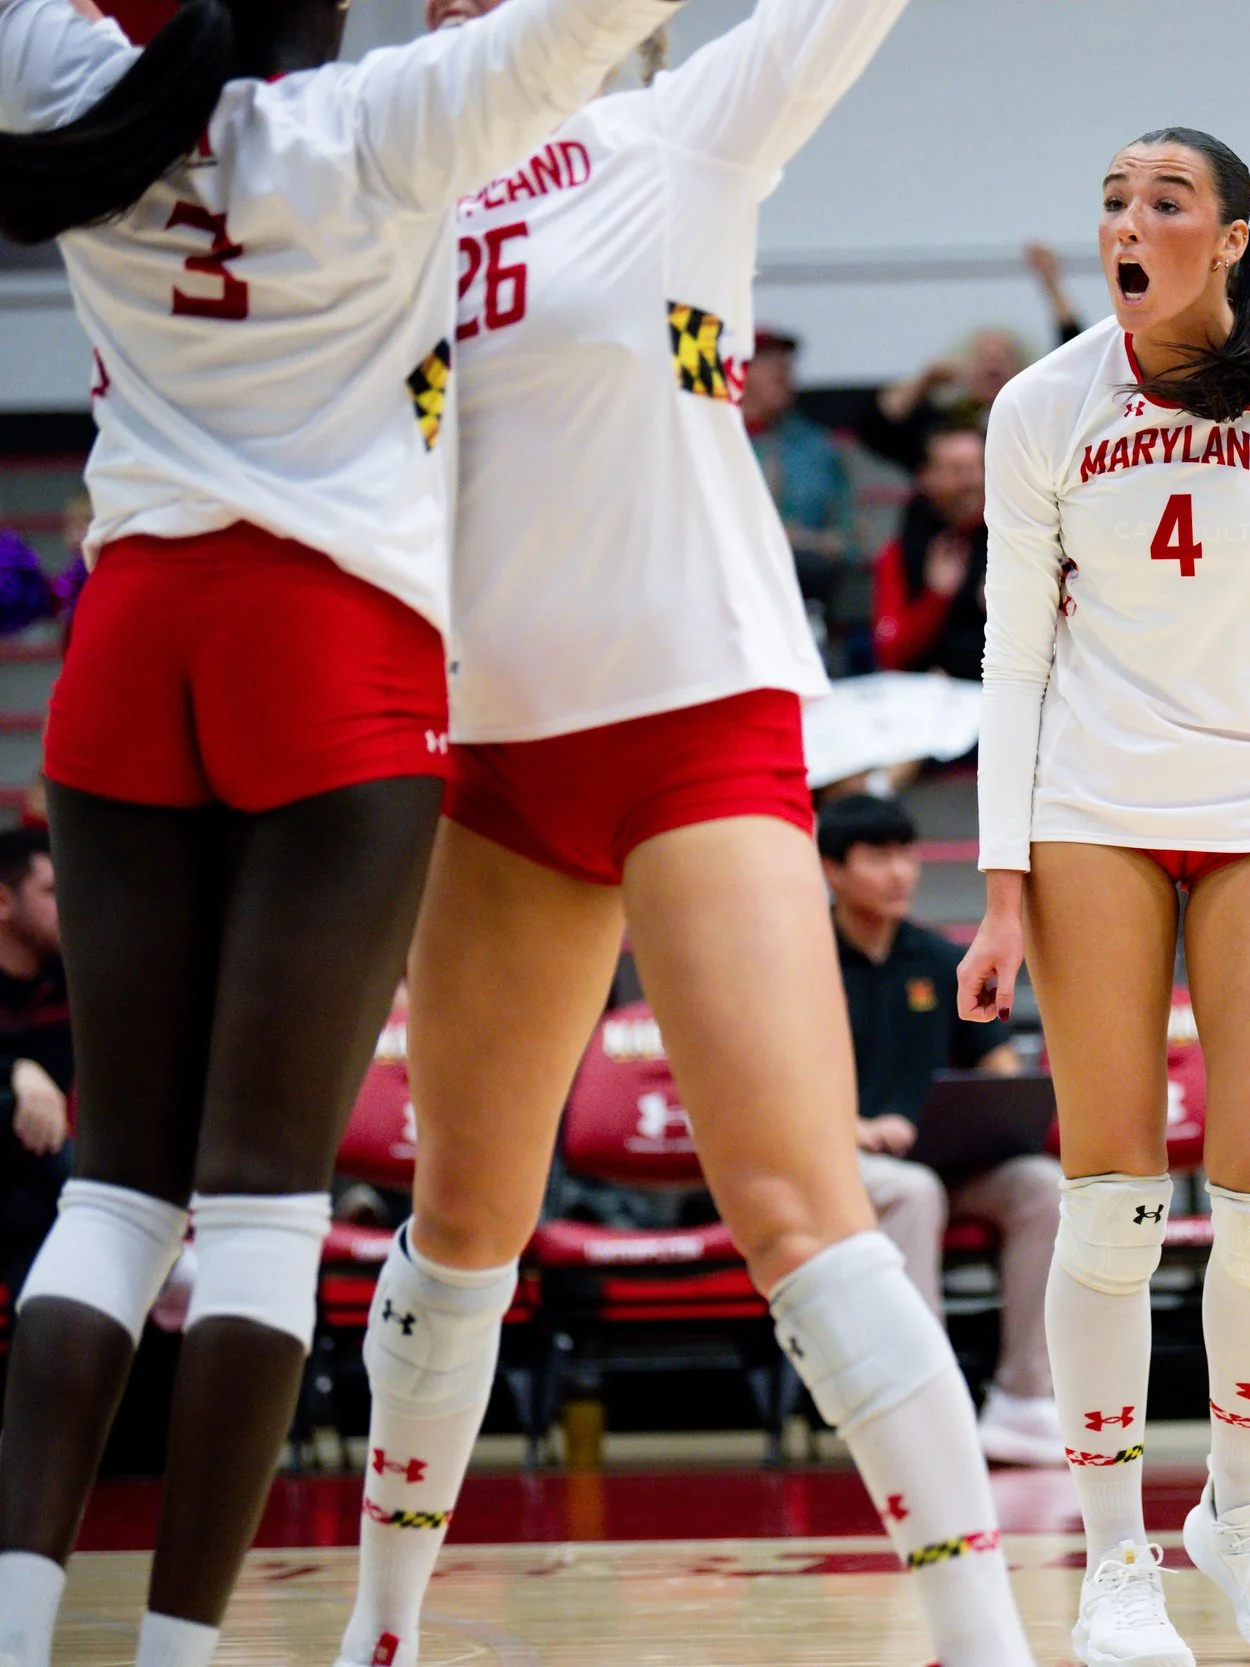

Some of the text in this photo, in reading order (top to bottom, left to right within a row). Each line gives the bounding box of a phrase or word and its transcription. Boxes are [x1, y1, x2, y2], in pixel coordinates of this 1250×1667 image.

[164, 199, 249, 320] 3
[456, 220, 529, 343] 26
[1114, 520, 1250, 542] CAULT
[1150, 493, 1203, 577] 4
